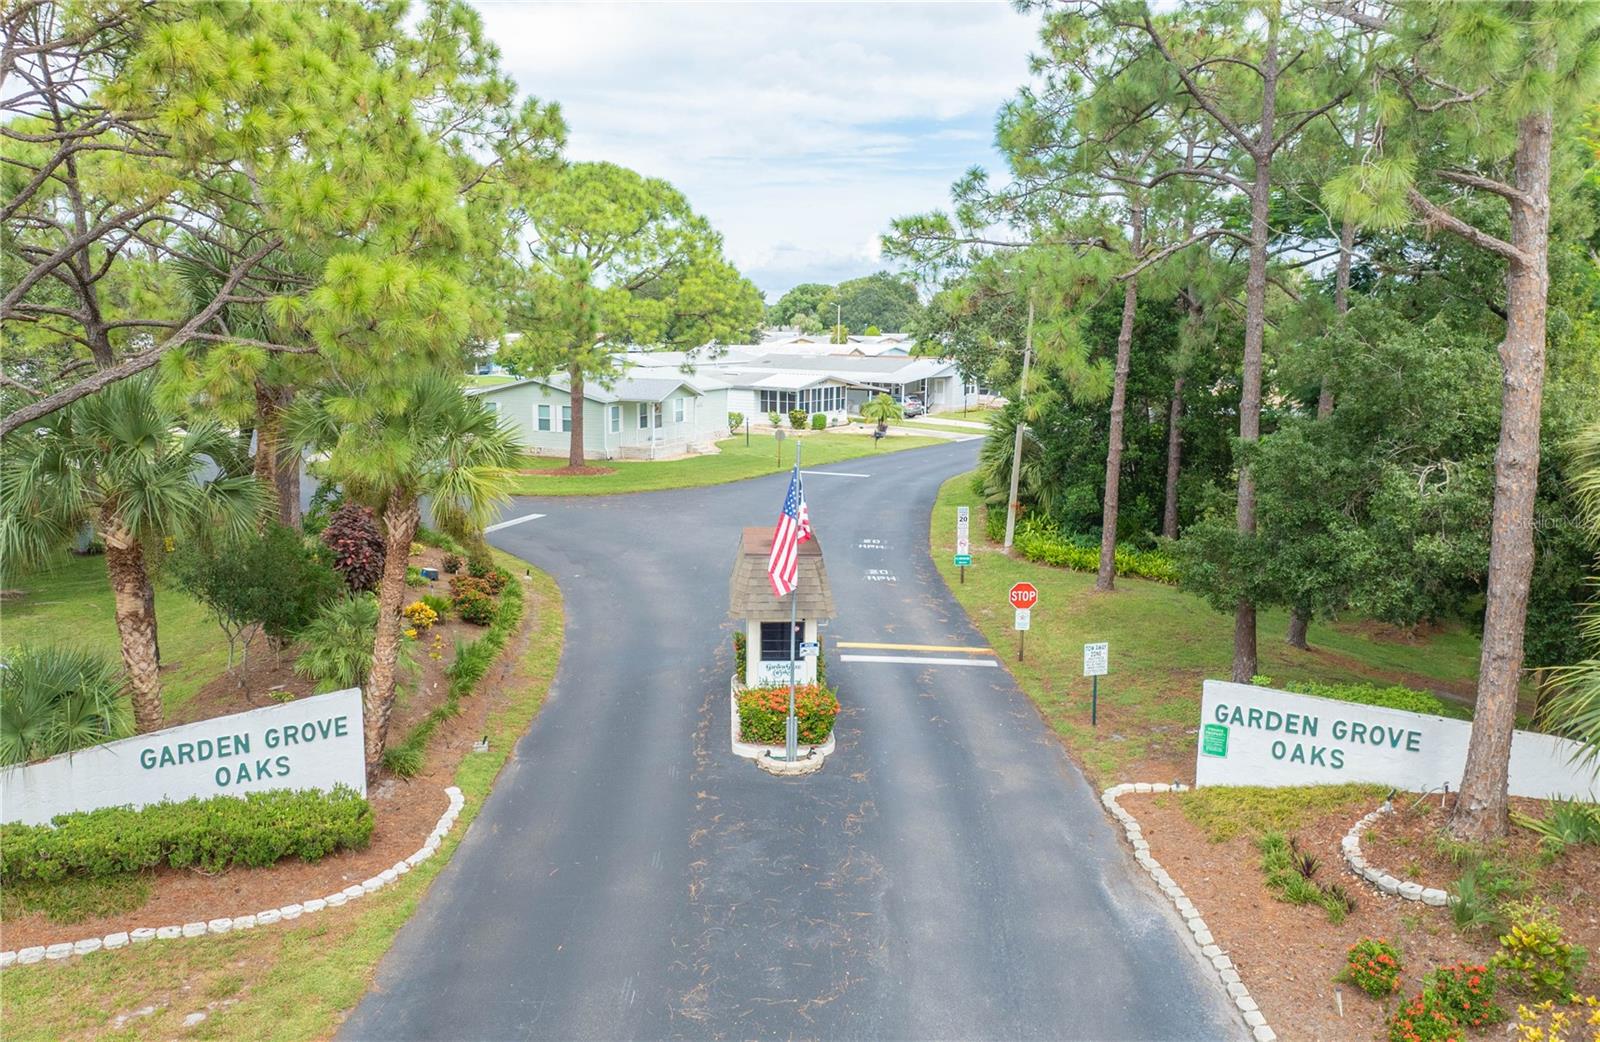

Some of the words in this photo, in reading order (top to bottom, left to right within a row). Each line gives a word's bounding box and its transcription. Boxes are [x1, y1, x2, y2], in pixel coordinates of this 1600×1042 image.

[1011, 590, 1036, 601] STOP
[140, 733, 250, 770] GARDEN
[264, 716, 348, 749] GROVE
[1215, 703, 1319, 737] GARDEN
[1332, 720, 1422, 752] GROVE
[1271, 740, 1345, 769] OAKS
[215, 755, 290, 787] OAKS
